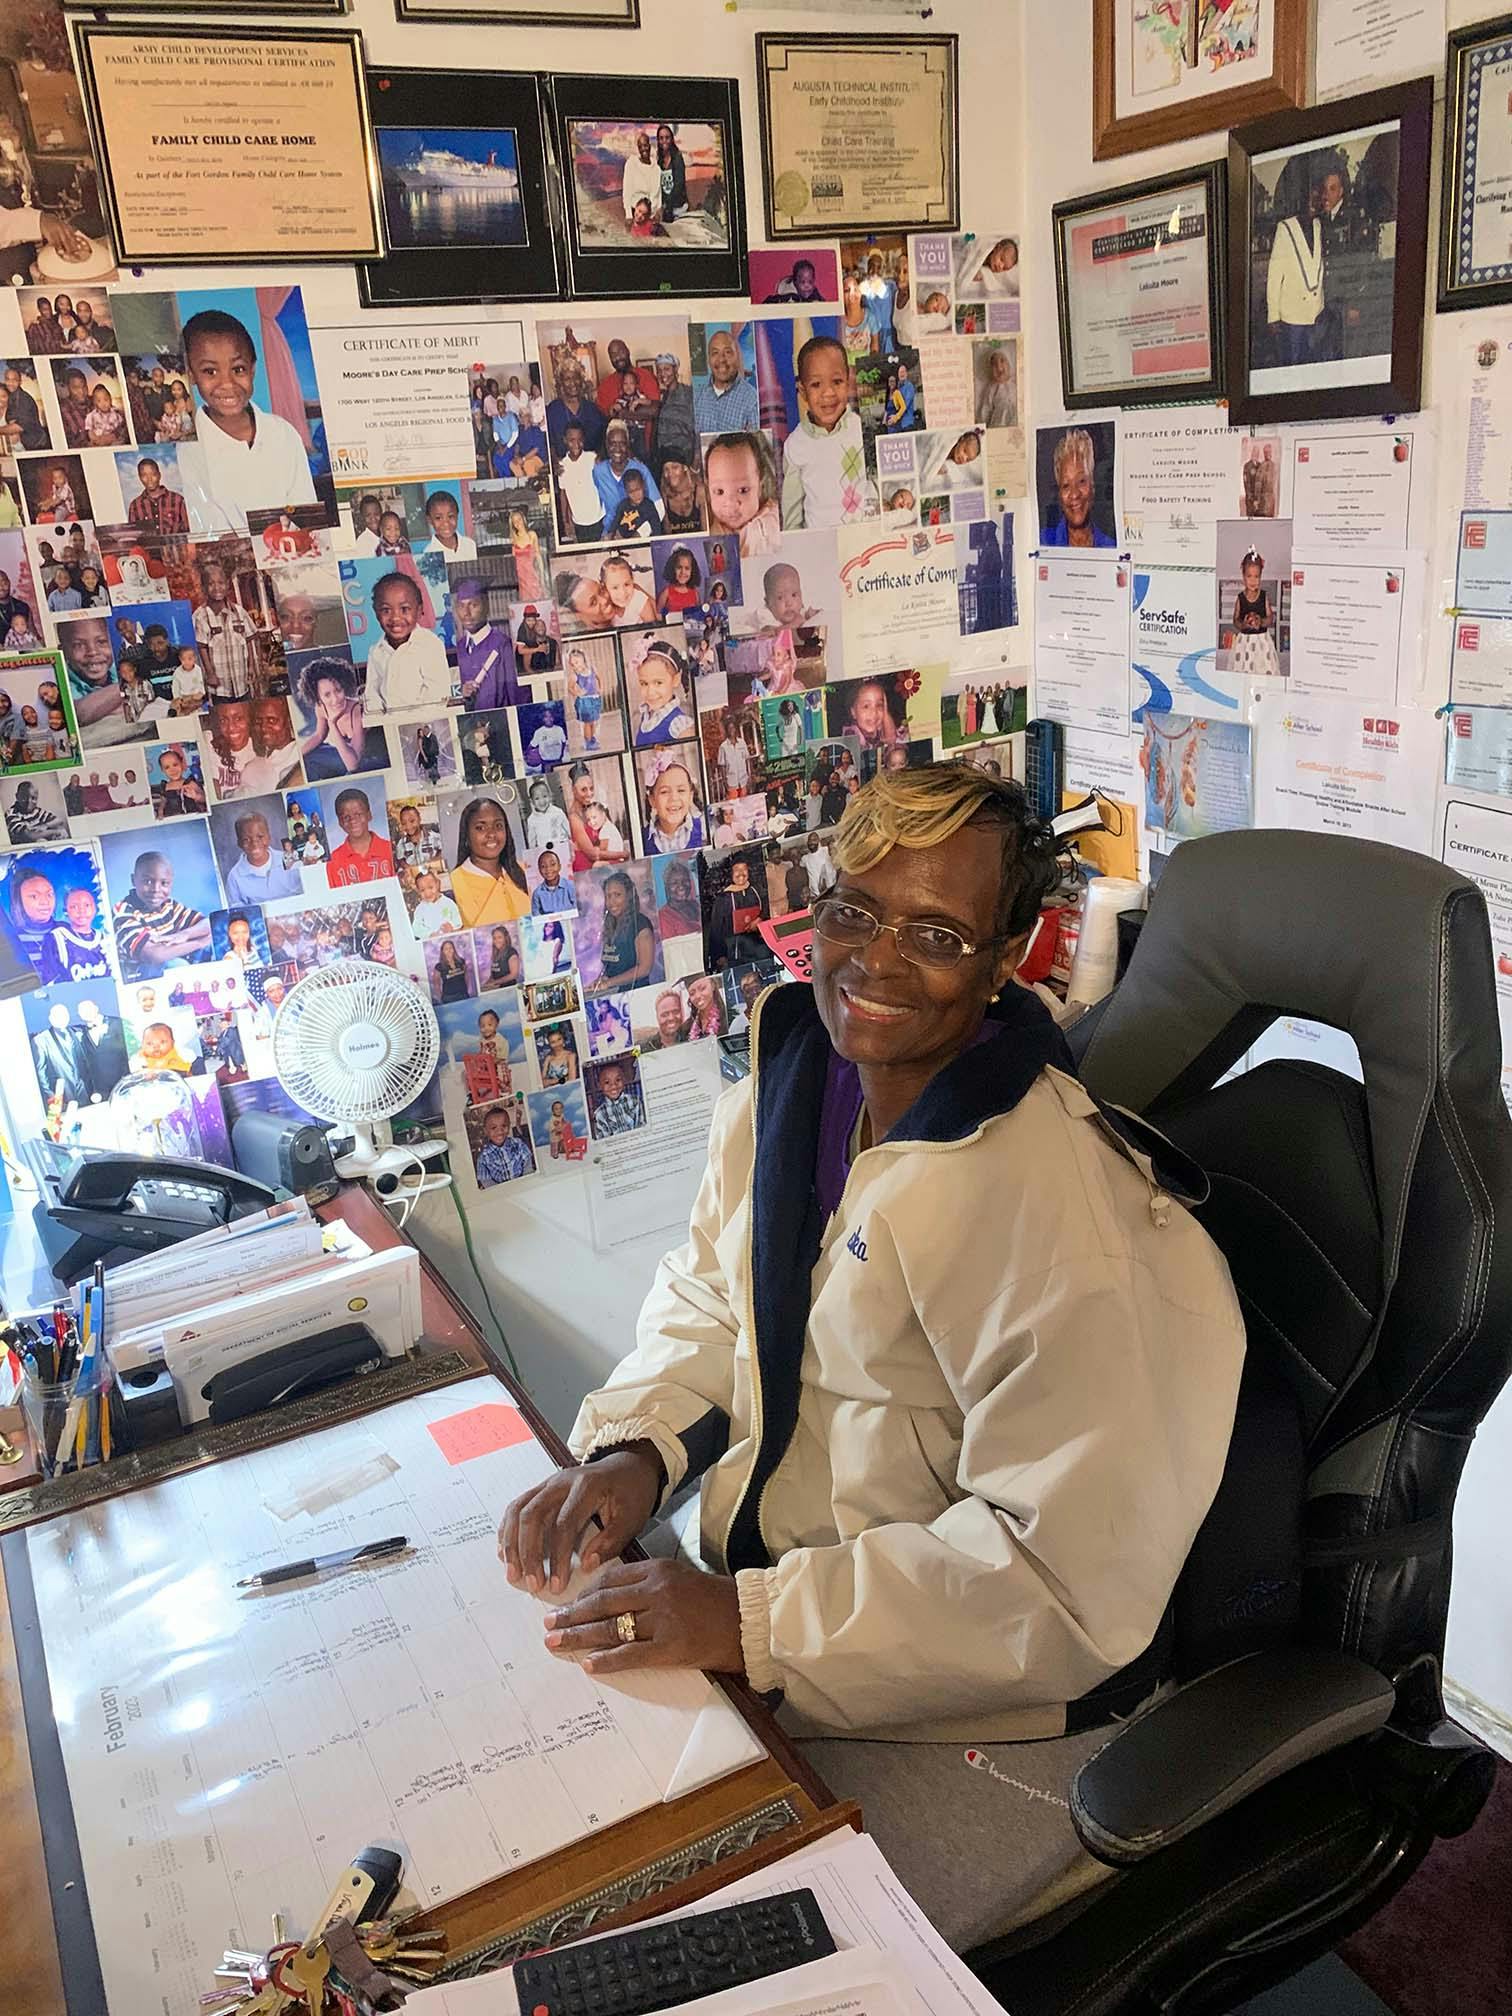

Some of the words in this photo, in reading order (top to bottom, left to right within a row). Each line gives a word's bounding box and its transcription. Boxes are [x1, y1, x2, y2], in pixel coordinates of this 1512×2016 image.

[132, 45, 158, 54] ARMY
[161, 45, 191, 54] CHILD
[194, 46, 264, 55] DEVELOPMENT
[267, 48, 309, 56] SERVICES
[105, 56, 140, 65] FAMILY
[144, 56, 173, 65] CHILD
[176, 57, 201, 66] CARE
[203, 57, 264, 67] PROVISIONAL
[267, 59, 336, 68] CERTIFICATION
[793, 81, 831, 92] AUGUSTA
[833, 82, 878, 93] TECHNICAL
[809, 96, 828, 107] Early
[830, 96, 870, 106] Childhood
[152, 135, 199, 146] FAMILY
[203, 135, 241, 146] CHILD
[245, 135, 278, 146] CARE
[281, 135, 316, 146] HOME
[821, 136, 842, 146] Child
[844, 136, 863, 146] Care
[865, 136, 895, 147] Training
[232, 171, 256, 180] Family
[258, 170, 277, 179] Child
[919, 252, 946, 264] YOU
[1161, 278, 1179, 287] Moore
[343, 337, 421, 352] CERTIFICATE
[424, 337, 440, 349] OF
[443, 336, 480, 348] MERIT
[382, 369, 399, 378] DAY
[401, 368, 422, 377] CARE
[424, 367, 446, 376] PREP
[410, 418, 445, 427] REGIONAL
[1124, 430, 1168, 439] ERTIFICATE
[1185, 426, 1240, 437] COMPLETION
[883, 450, 910, 463] YOU
[1159, 496, 1181, 504] SAFETY
[1182, 496, 1212, 504] TRAINING
[857, 571, 912, 593] Certificate
[914, 566, 926, 585] of
[1139, 608, 1187, 625] ServSafe
[1139, 622, 1188, 636] CERTIFICATION
[1449, 840, 1510, 863] CERTIFICATE
[1480, 878, 1499, 890] Menu
[102, 1685, 127, 1754] February
[964, 1748, 1070, 1809] Champion
[588, 1812, 599, 1825] 26
[511, 1847, 521, 1860] 19
[430, 1884, 441, 1897] 12
